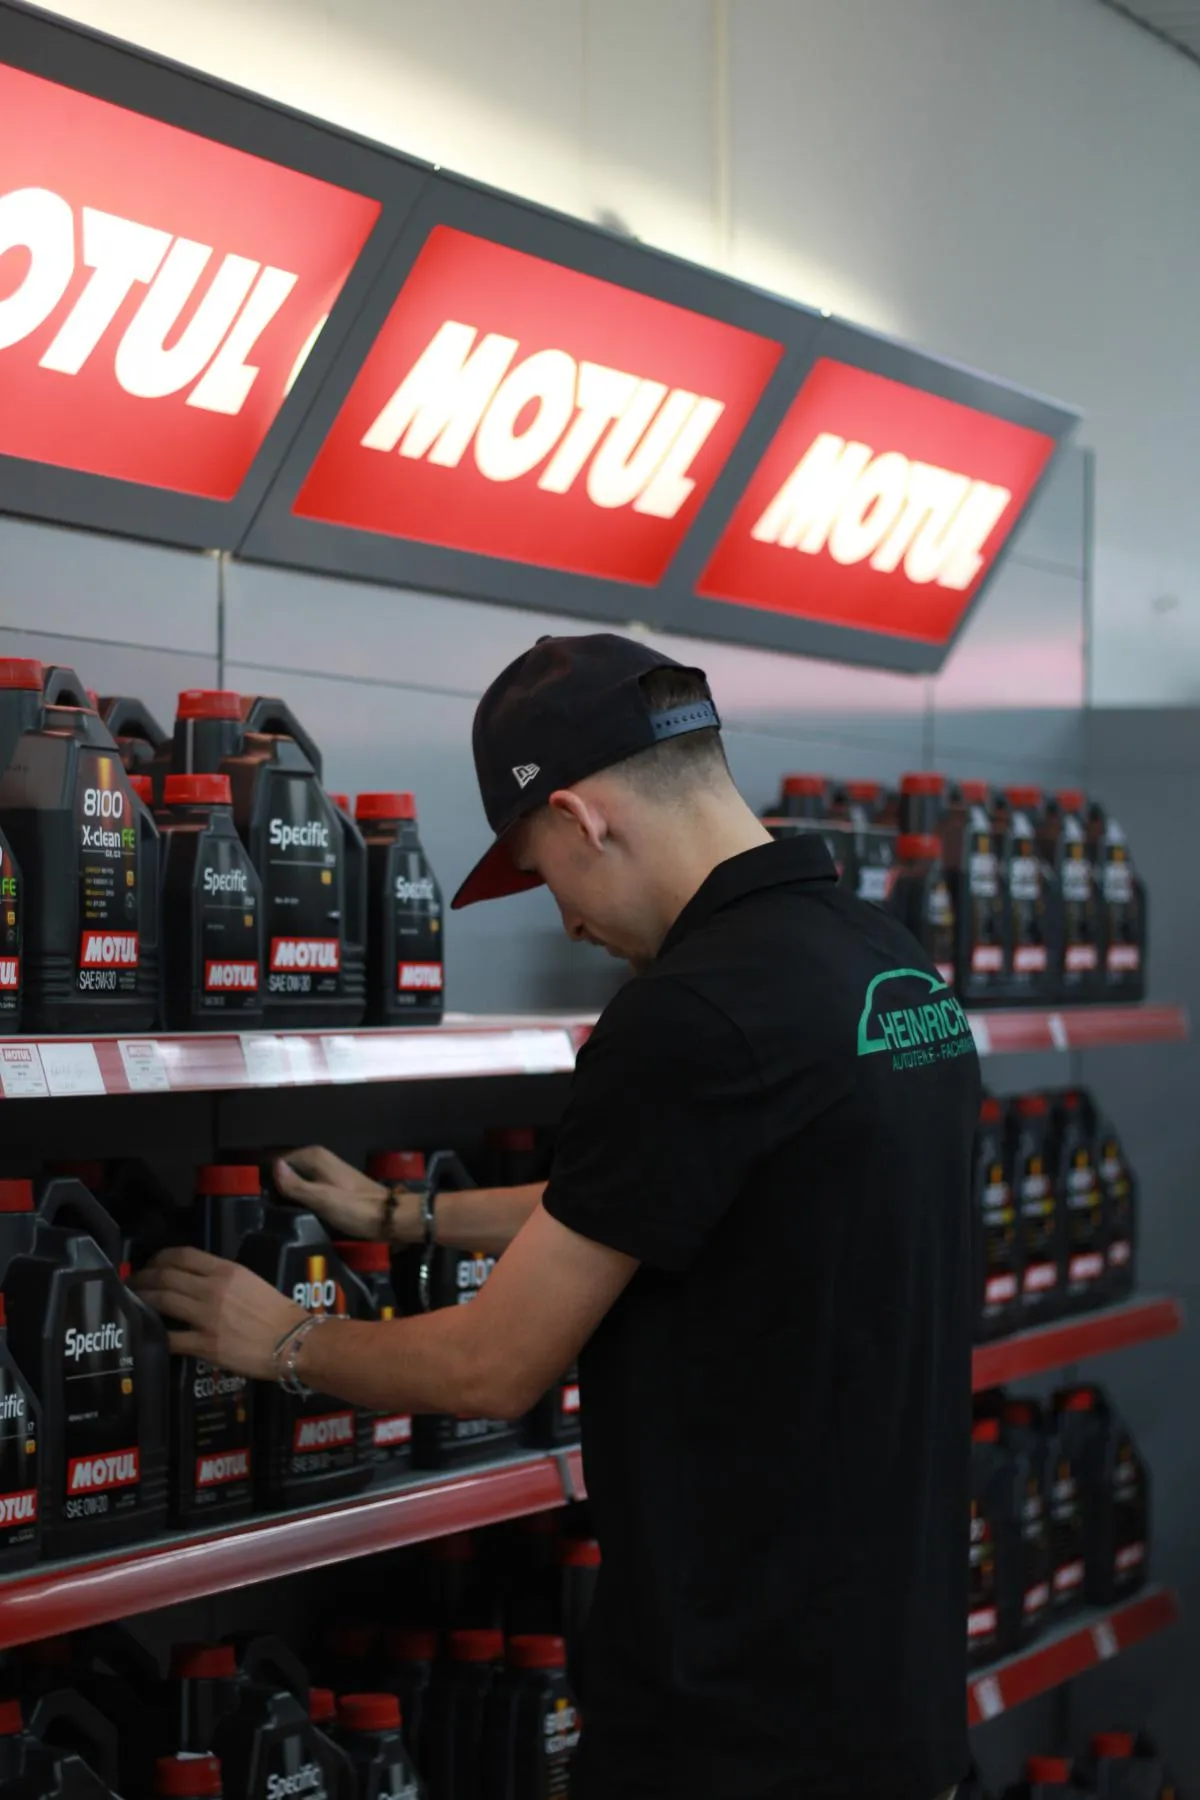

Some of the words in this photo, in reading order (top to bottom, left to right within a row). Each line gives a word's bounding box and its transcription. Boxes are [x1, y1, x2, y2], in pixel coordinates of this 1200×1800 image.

[0, 187, 299, 415] OTUL
[361, 320, 725, 519] MOTUL
[751, 432, 1011, 591] MOTUL
[84, 788, 123, 818] 8100
[82, 825, 121, 848] X-clean
[122, 828, 136, 848] FE
[269, 818, 329, 850] Specific
[203, 867, 247, 896] Specific
[396, 876, 434, 903] Specific
[84, 936, 137, 963] MOTUL
[273, 941, 339, 968] MOTUL
[79, 970, 95, 990] SAE
[208, 965, 257, 986] MOTUL
[268, 974, 286, 992] SAE
[400, 965, 442, 987] MOTUL
[878, 997, 970, 1050] HEINRICH
[293, 1280, 335, 1308] 8100
[64, 1324, 124, 1361] Specific
[298, 1416, 354, 1448] MOTUL
[72, 1453, 137, 1489] MOTUL
[199, 1454, 248, 1484] MOTUL
[0, 1494, 36, 1523] OTUL
[66, 1499, 83, 1519] SAE
